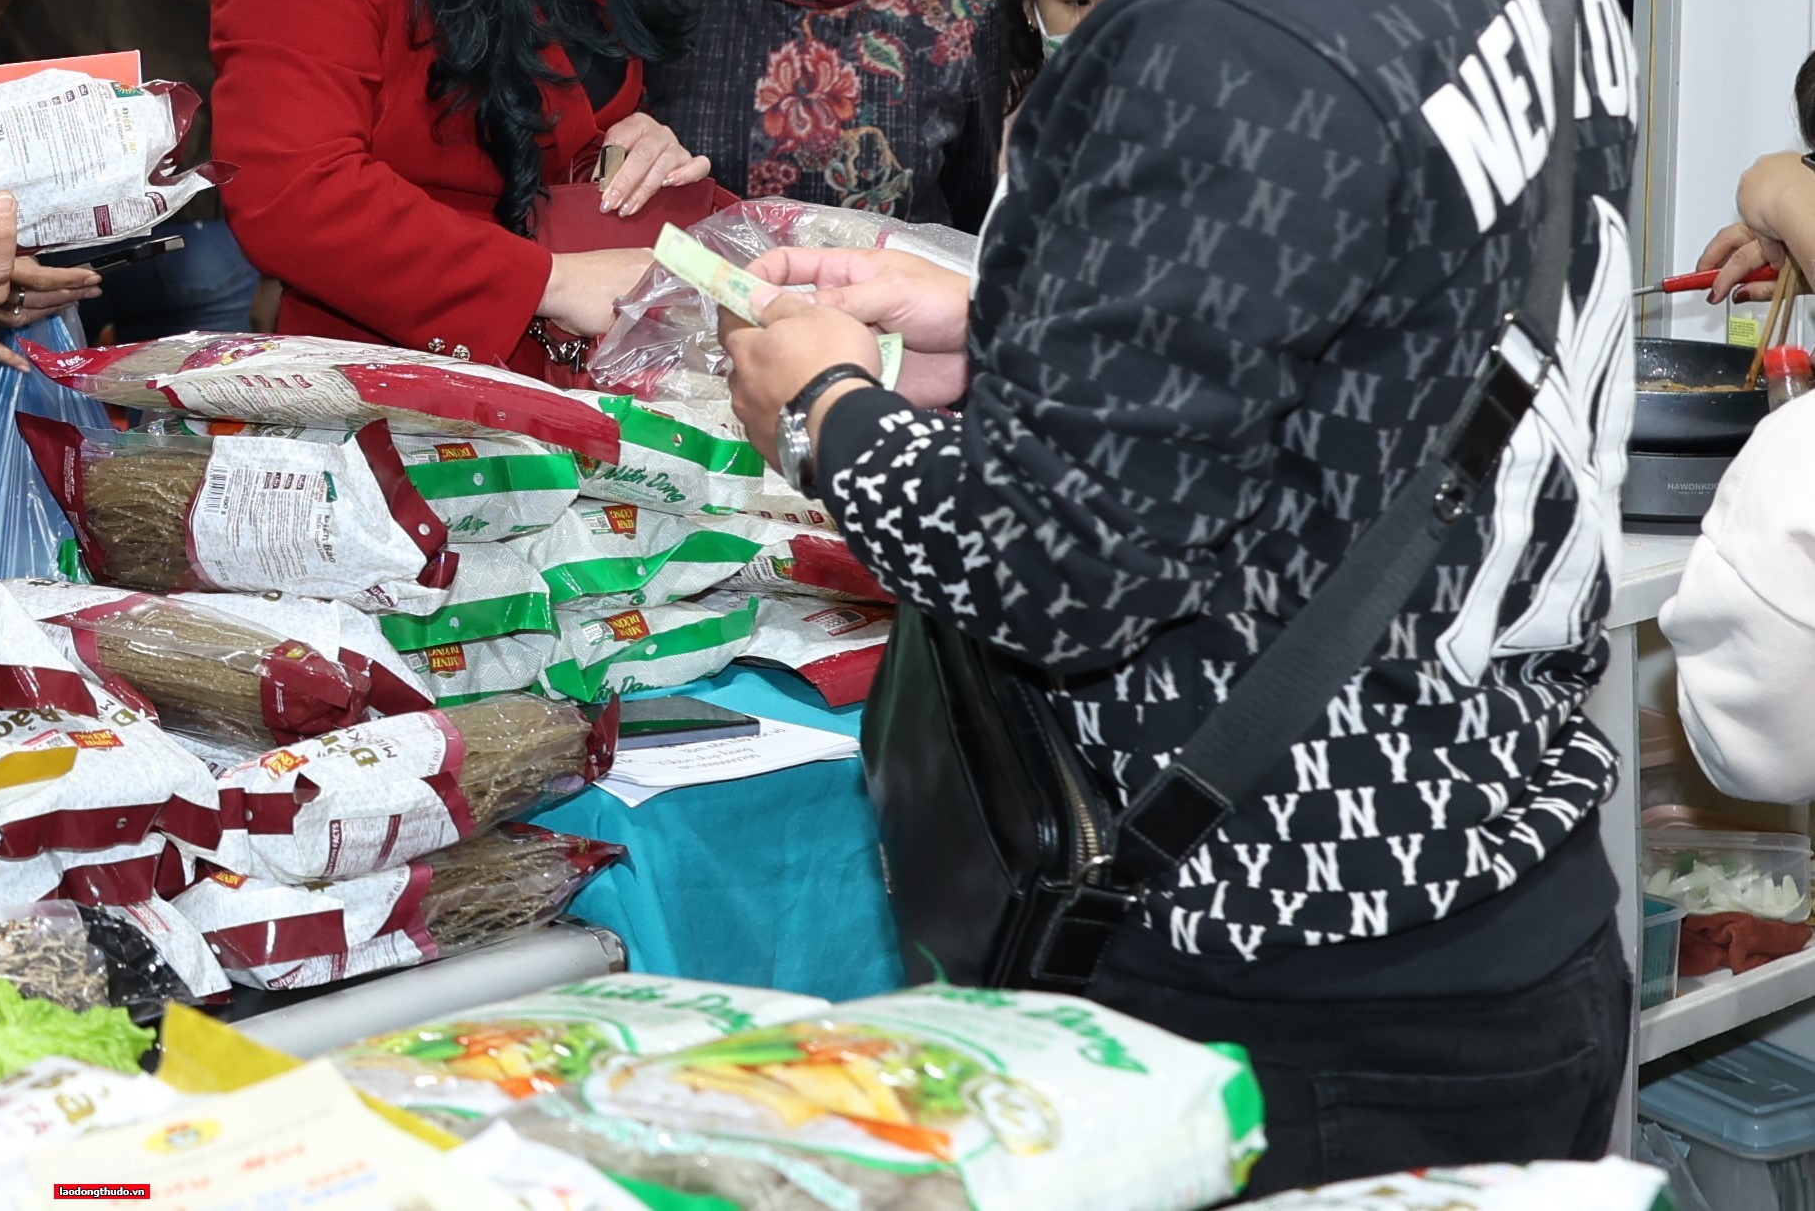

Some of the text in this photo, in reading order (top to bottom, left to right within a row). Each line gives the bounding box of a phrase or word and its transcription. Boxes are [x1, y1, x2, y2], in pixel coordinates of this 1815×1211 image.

[645, 472, 686, 503] Dong
[432, 656, 460, 668] MINH
[1291, 740, 1332, 792] N
[1374, 732, 1411, 784] Y
[1263, 793, 1300, 842] Y
[1336, 787, 1381, 840] N
[1416, 778, 1452, 830] Y
[330, 821, 341, 849] FACTS
[1386, 833, 1425, 887] Y
[1233, 843, 1273, 889] Y
[1302, 841, 1344, 892] N
[1348, 890, 1389, 938] N
